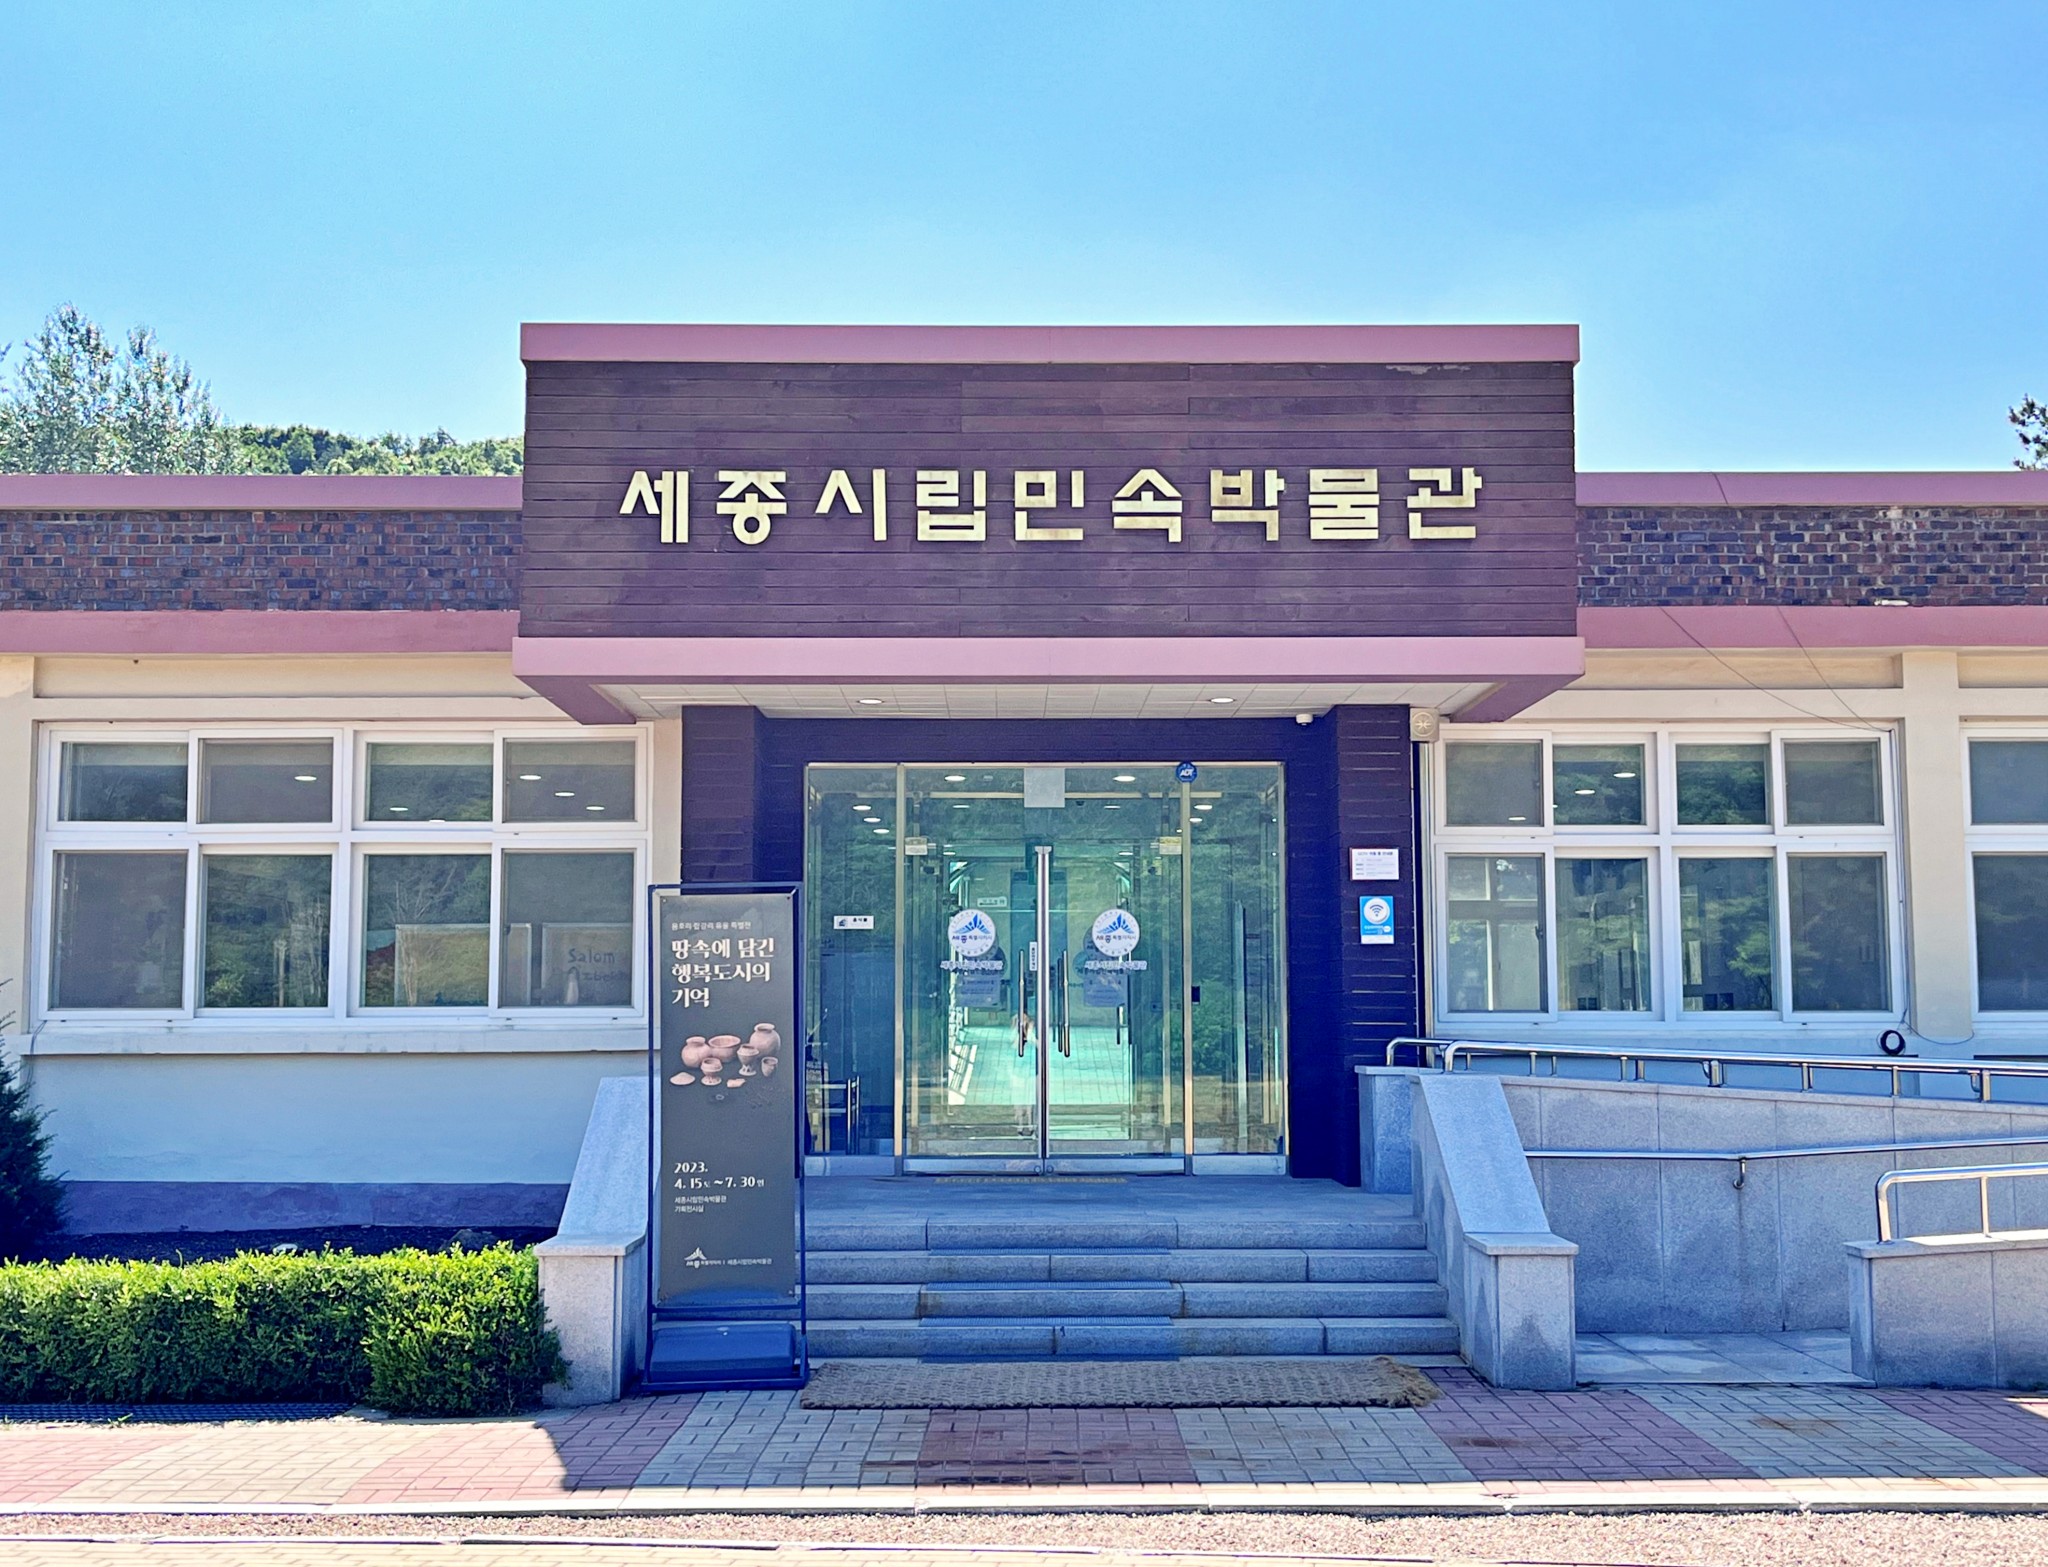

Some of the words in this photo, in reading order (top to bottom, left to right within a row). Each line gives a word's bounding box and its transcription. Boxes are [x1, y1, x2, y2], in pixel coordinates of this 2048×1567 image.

[619, 467, 1484, 545] 세종시립민속박물관
[671, 938, 731, 960] 땅속에
[738, 937, 774, 959] 담긴
[671, 961, 770, 984] 행복도시의
[671, 987, 710, 1009] 기억
[674, 1161, 709, 1174] 2023.
